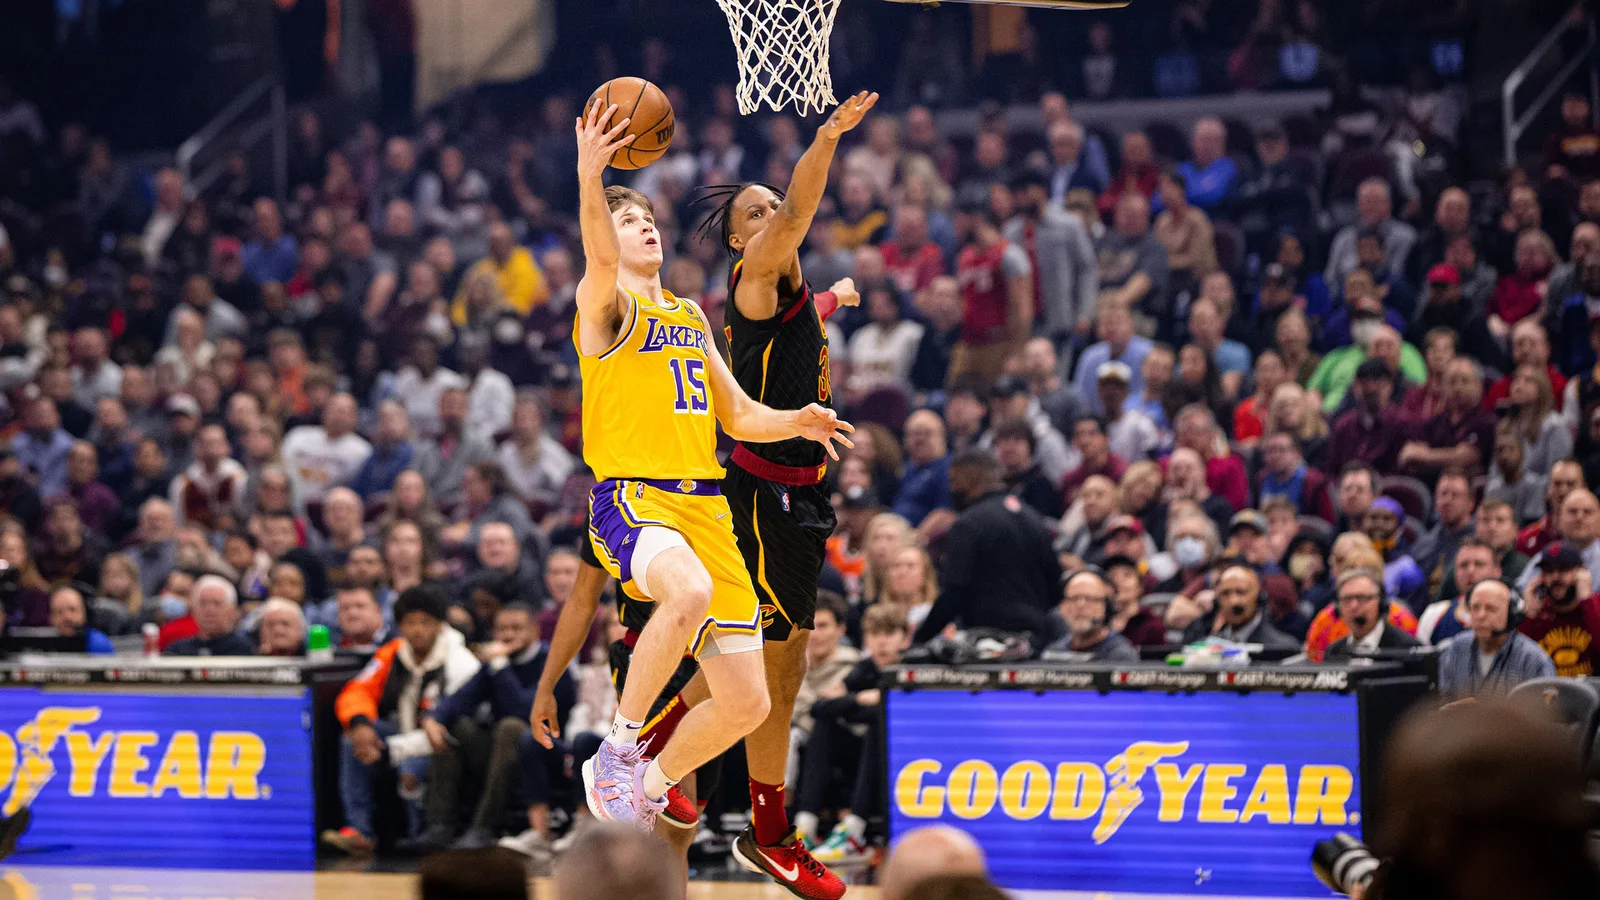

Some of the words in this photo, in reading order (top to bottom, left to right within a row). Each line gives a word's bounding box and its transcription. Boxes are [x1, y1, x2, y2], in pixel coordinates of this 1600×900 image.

[637, 317, 708, 357] LAKERS
[669, 358, 709, 416] 15
[1312, 671, 1348, 689] ANC
